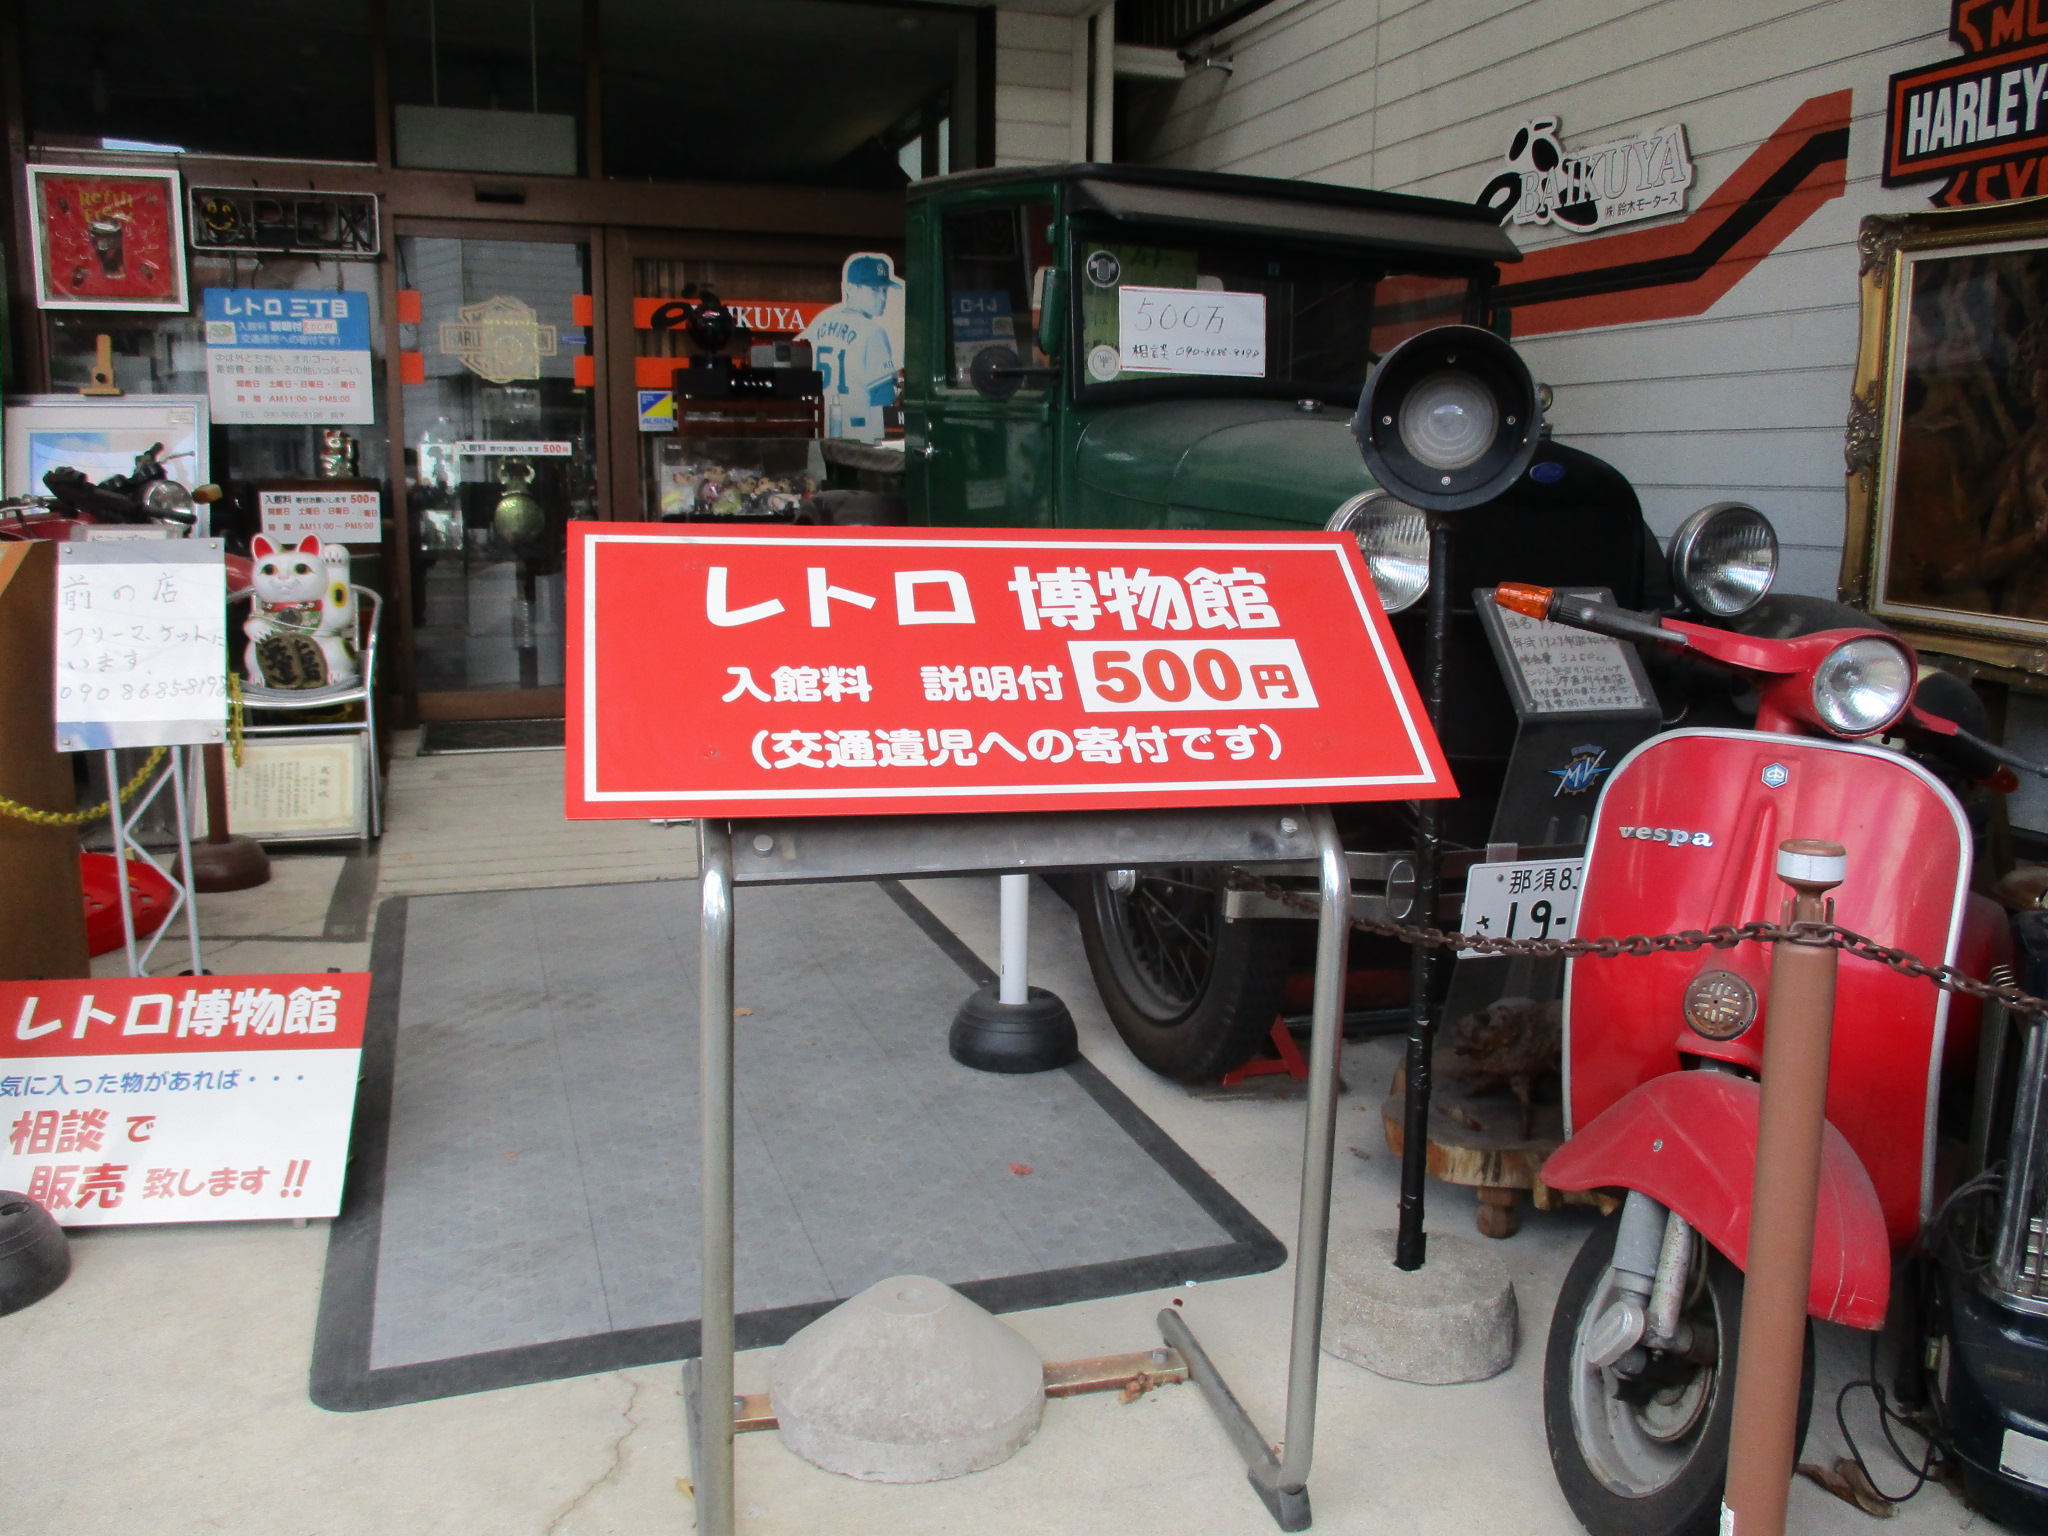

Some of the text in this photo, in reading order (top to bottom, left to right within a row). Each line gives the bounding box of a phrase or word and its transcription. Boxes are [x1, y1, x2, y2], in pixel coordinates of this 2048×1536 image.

[1517, 132, 1686, 219] BAIKUYA
[224, 297, 348, 318] レトロ 三丁目
[817, 321, 857, 345] ICHIRO
[816, 345, 849, 394] 51
[706, 566, 1281, 631] レトロ 博物館
[722, 648, 1300, 704] 入館料 説明付 500円
[1619, 826, 1713, 847] vespa
[16, 986, 341, 1041] レトロ博物館
